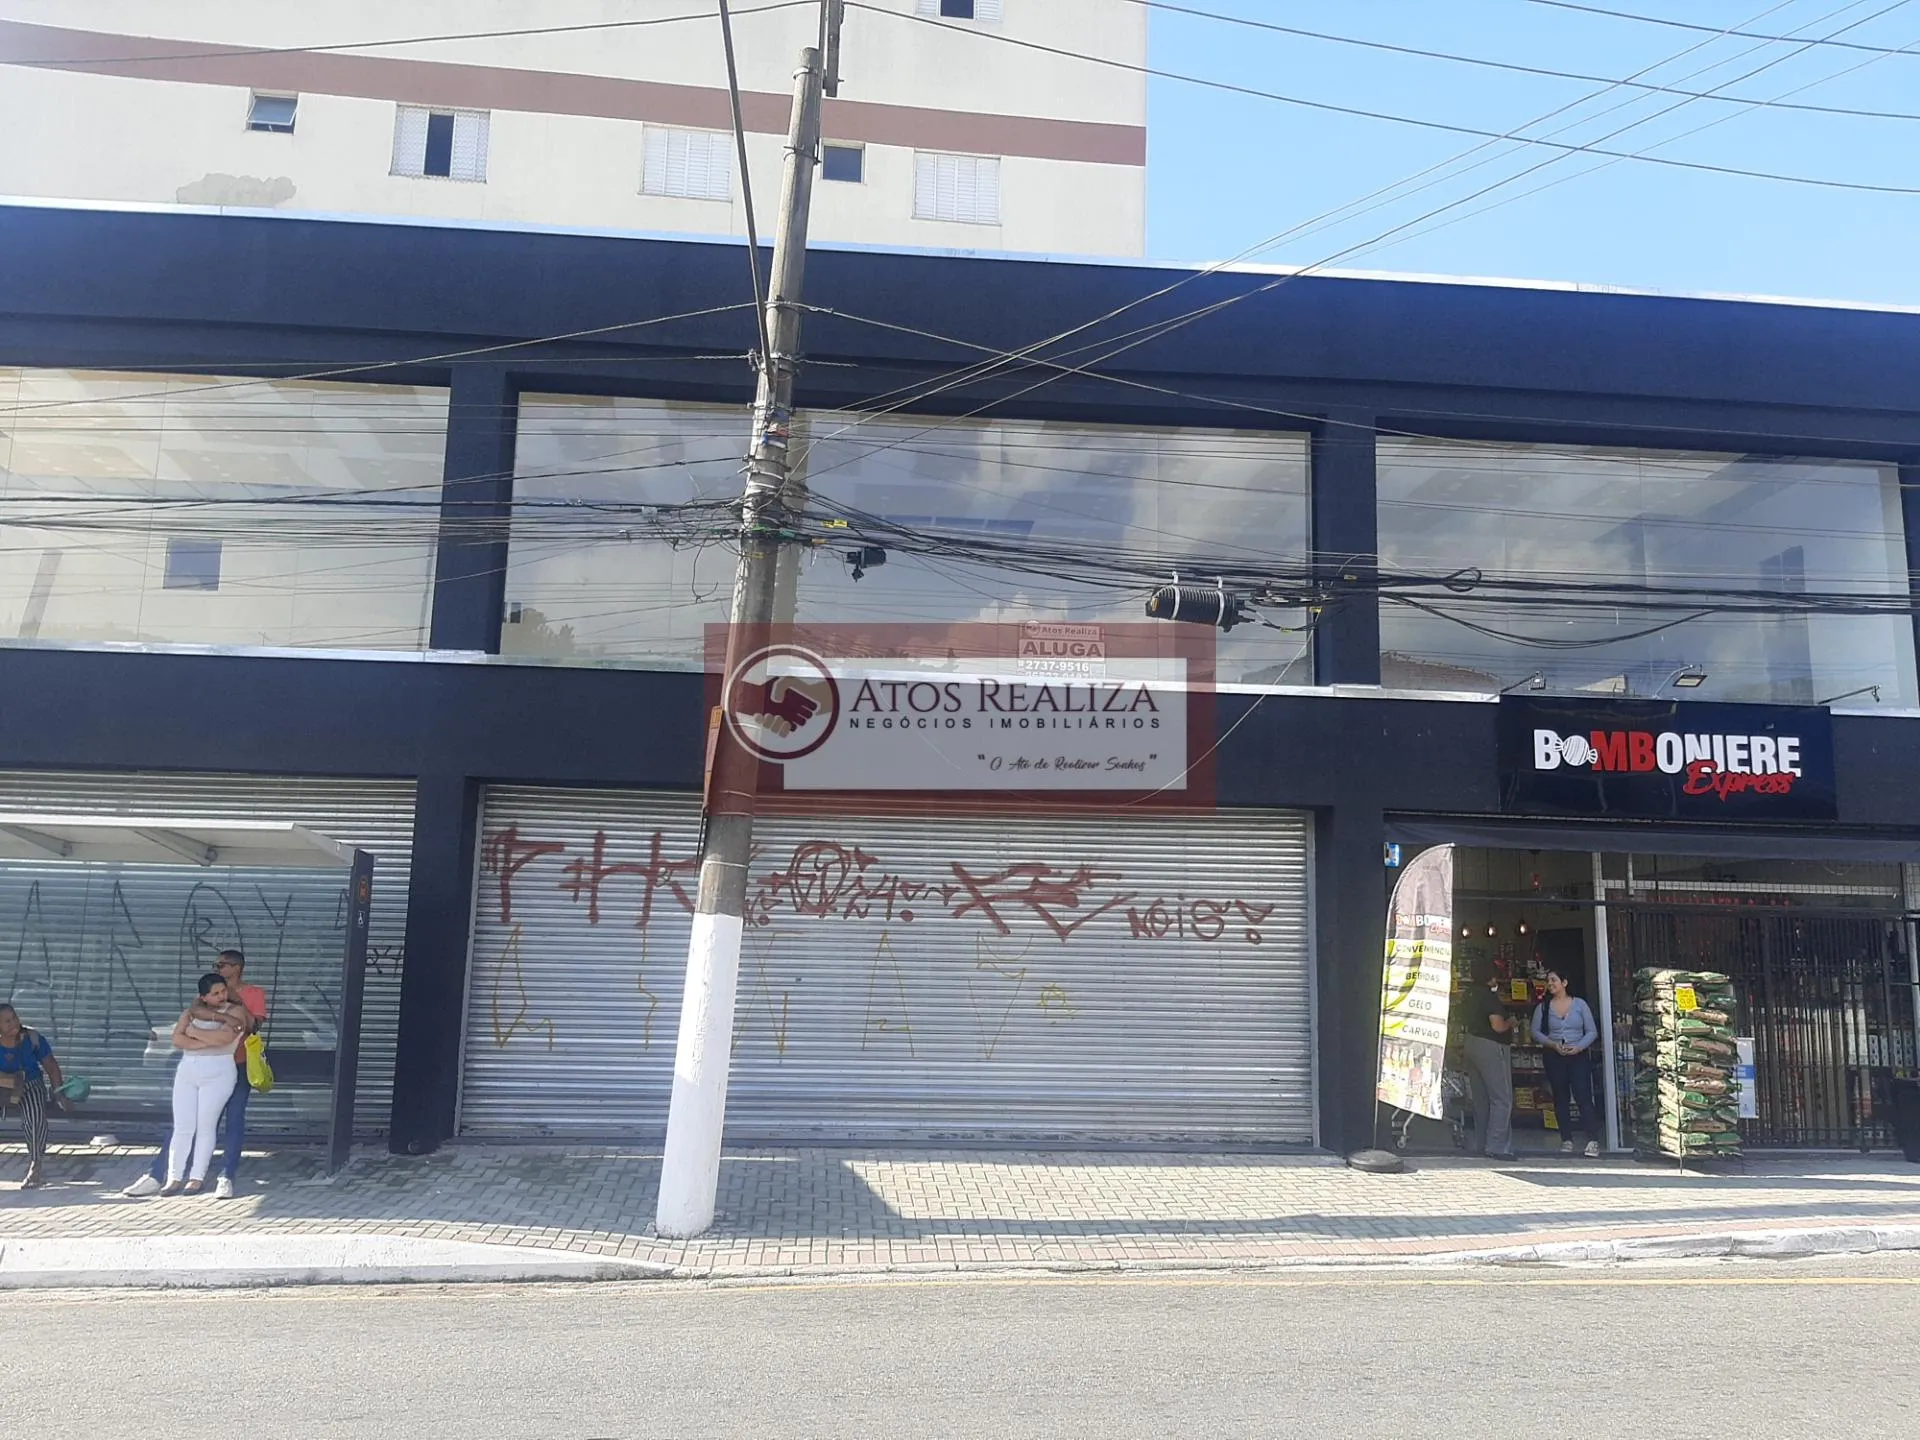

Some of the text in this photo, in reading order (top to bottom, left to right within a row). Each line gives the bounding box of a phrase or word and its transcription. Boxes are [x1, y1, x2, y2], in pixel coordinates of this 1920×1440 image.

[1022, 641, 1102, 657] ALUGA
[1025, 660, 1089, 672] 2737-9516
[1682, 759, 1796, 802] Express
[1405, 971, 1441, 983] BEBIDAS
[1408, 999, 1432, 1011] GELO
